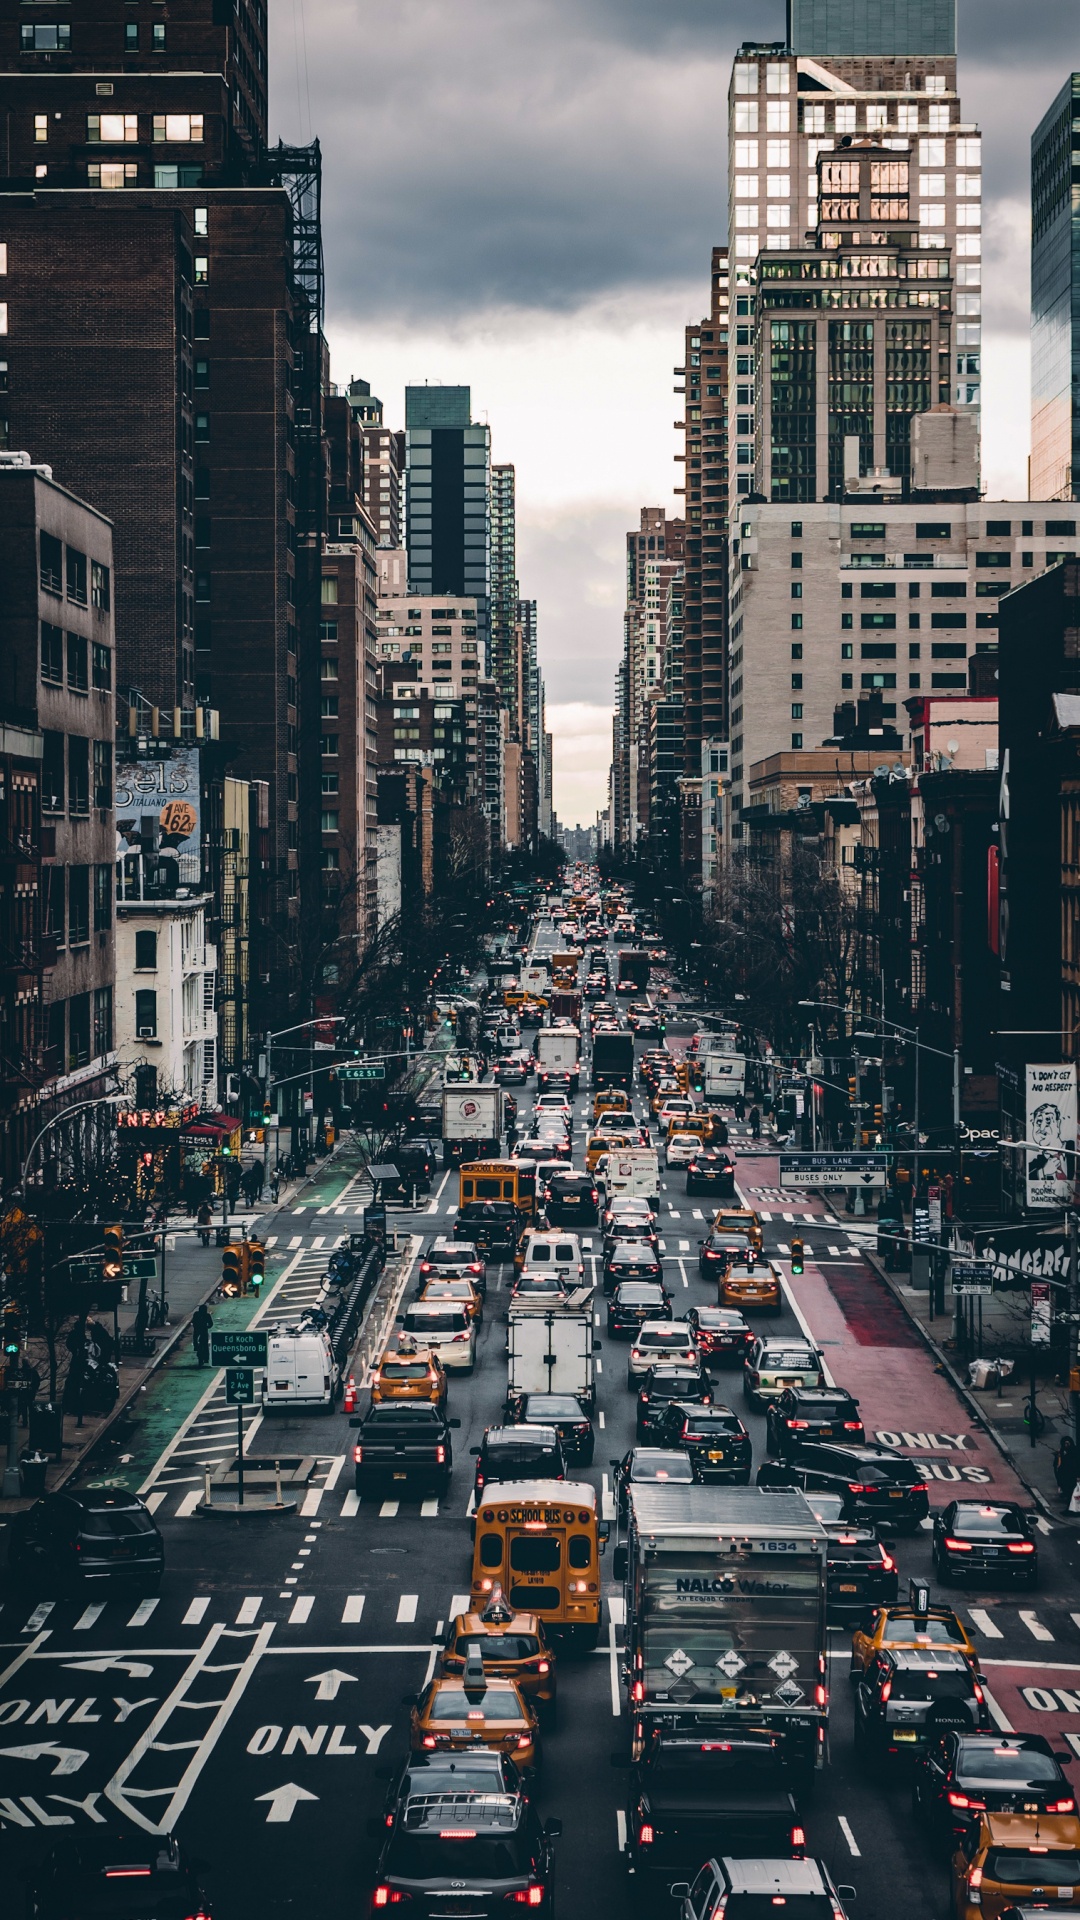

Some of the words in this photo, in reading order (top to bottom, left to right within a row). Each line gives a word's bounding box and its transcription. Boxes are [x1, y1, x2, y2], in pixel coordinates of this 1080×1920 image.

[133, 798, 166, 807] ITALIANO
[165, 803, 173, 825] 1
[174, 803, 189, 814] AVE
[171, 814, 191, 832] 62
[186, 822, 197, 832] ST
[346, 1070, 352, 1078] E
[353, 1070, 364, 1078] 62
[366, 1069, 376, 1077] St
[1038, 1070, 1058, 1081] DON'T
[1059, 1070, 1071, 1080] GET
[1031, 1083, 1043, 1092] NO
[811, 1157, 827, 1165] BUS
[832, 1157, 853, 1165] LANE
[749, 1187, 808, 1196] ONLY
[760, 1196, 810, 1204] BUS
[121, 1264, 138, 1275] St
[224, 1335, 234, 1343] Ed
[235, 1335, 254, 1343] Koch
[212, 1344, 257, 1352] Queensboro
[258, 1344, 266, 1352] Br
[235, 1372, 245, 1380] TO
[876, 1431, 969, 1450] ONLY
[914, 1463, 991, 1483] BUS
[511, 1508, 543, 1522] SCHOOL
[544, 1509, 560, 1522] BUS
[759, 1543, 797, 1551] 1634
[676, 1578, 735, 1593] NALCO
[738, 1579, 790, 1594] Water
[718, 1596, 755, 1604] Company
[0, 1697, 160, 1725] ONLY
[246, 1725, 392, 1755] ONLY
